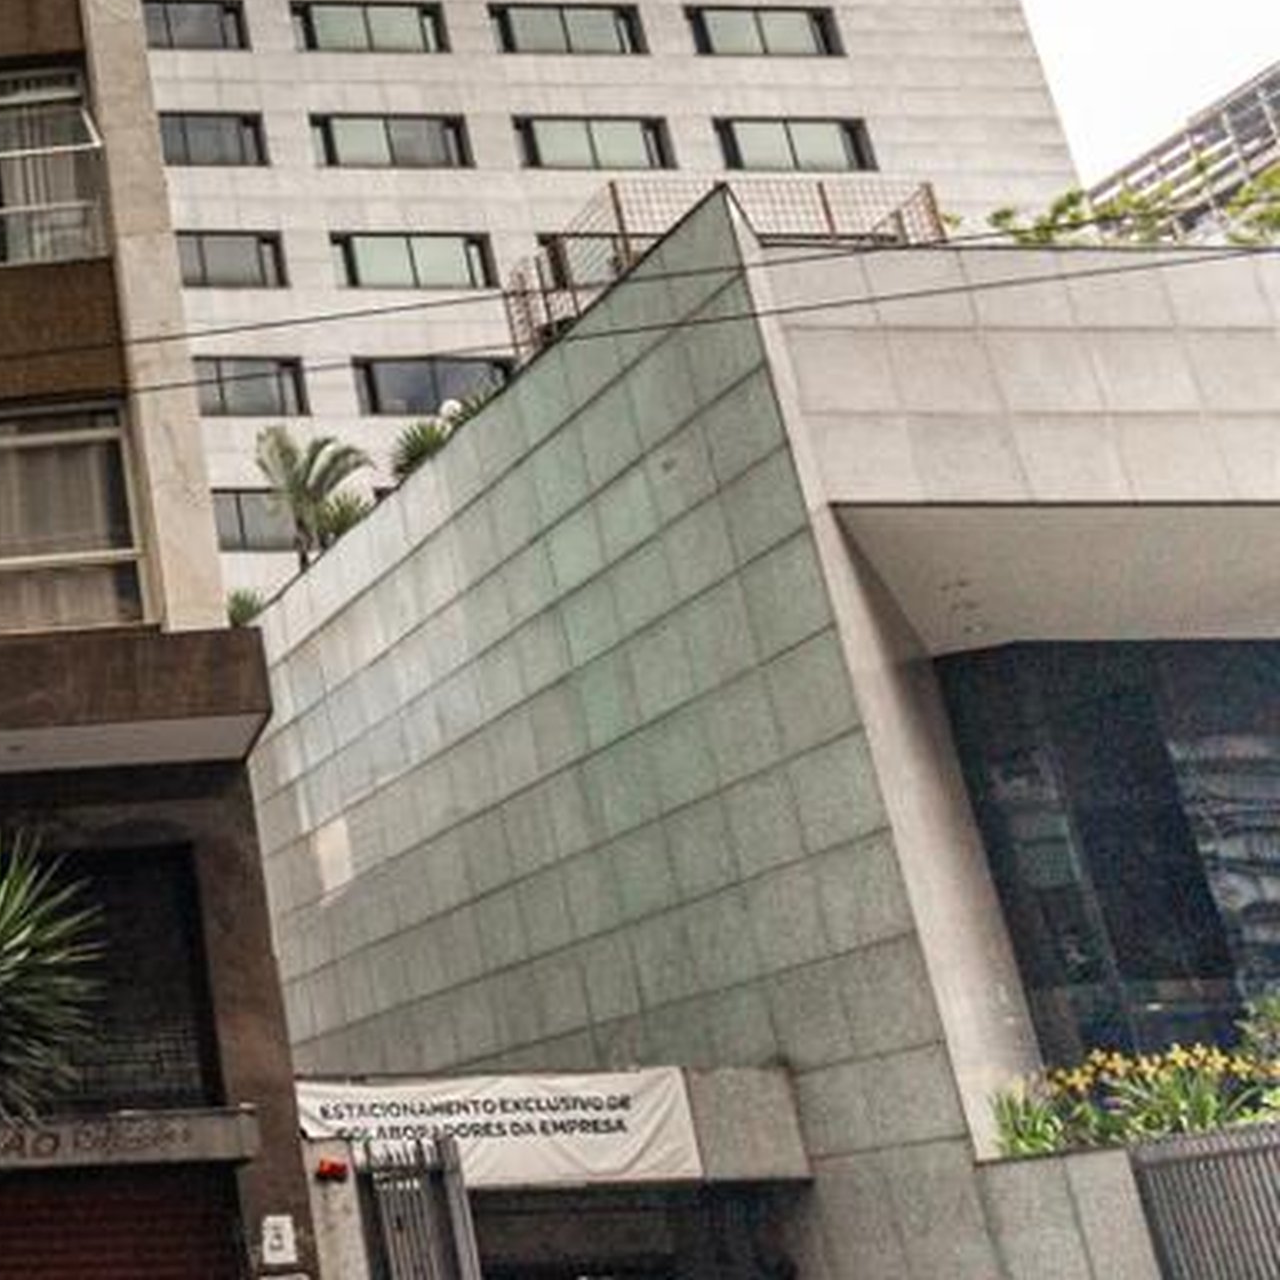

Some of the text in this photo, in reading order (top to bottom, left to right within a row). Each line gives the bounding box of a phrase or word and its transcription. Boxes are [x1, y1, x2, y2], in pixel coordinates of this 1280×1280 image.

[320, 1094, 632, 1119] ESTACIONAMENTO EXCLUSIVO DE
[509, 1120, 536, 1137] DA
[539, 1118, 628, 1136] EMPRESA
